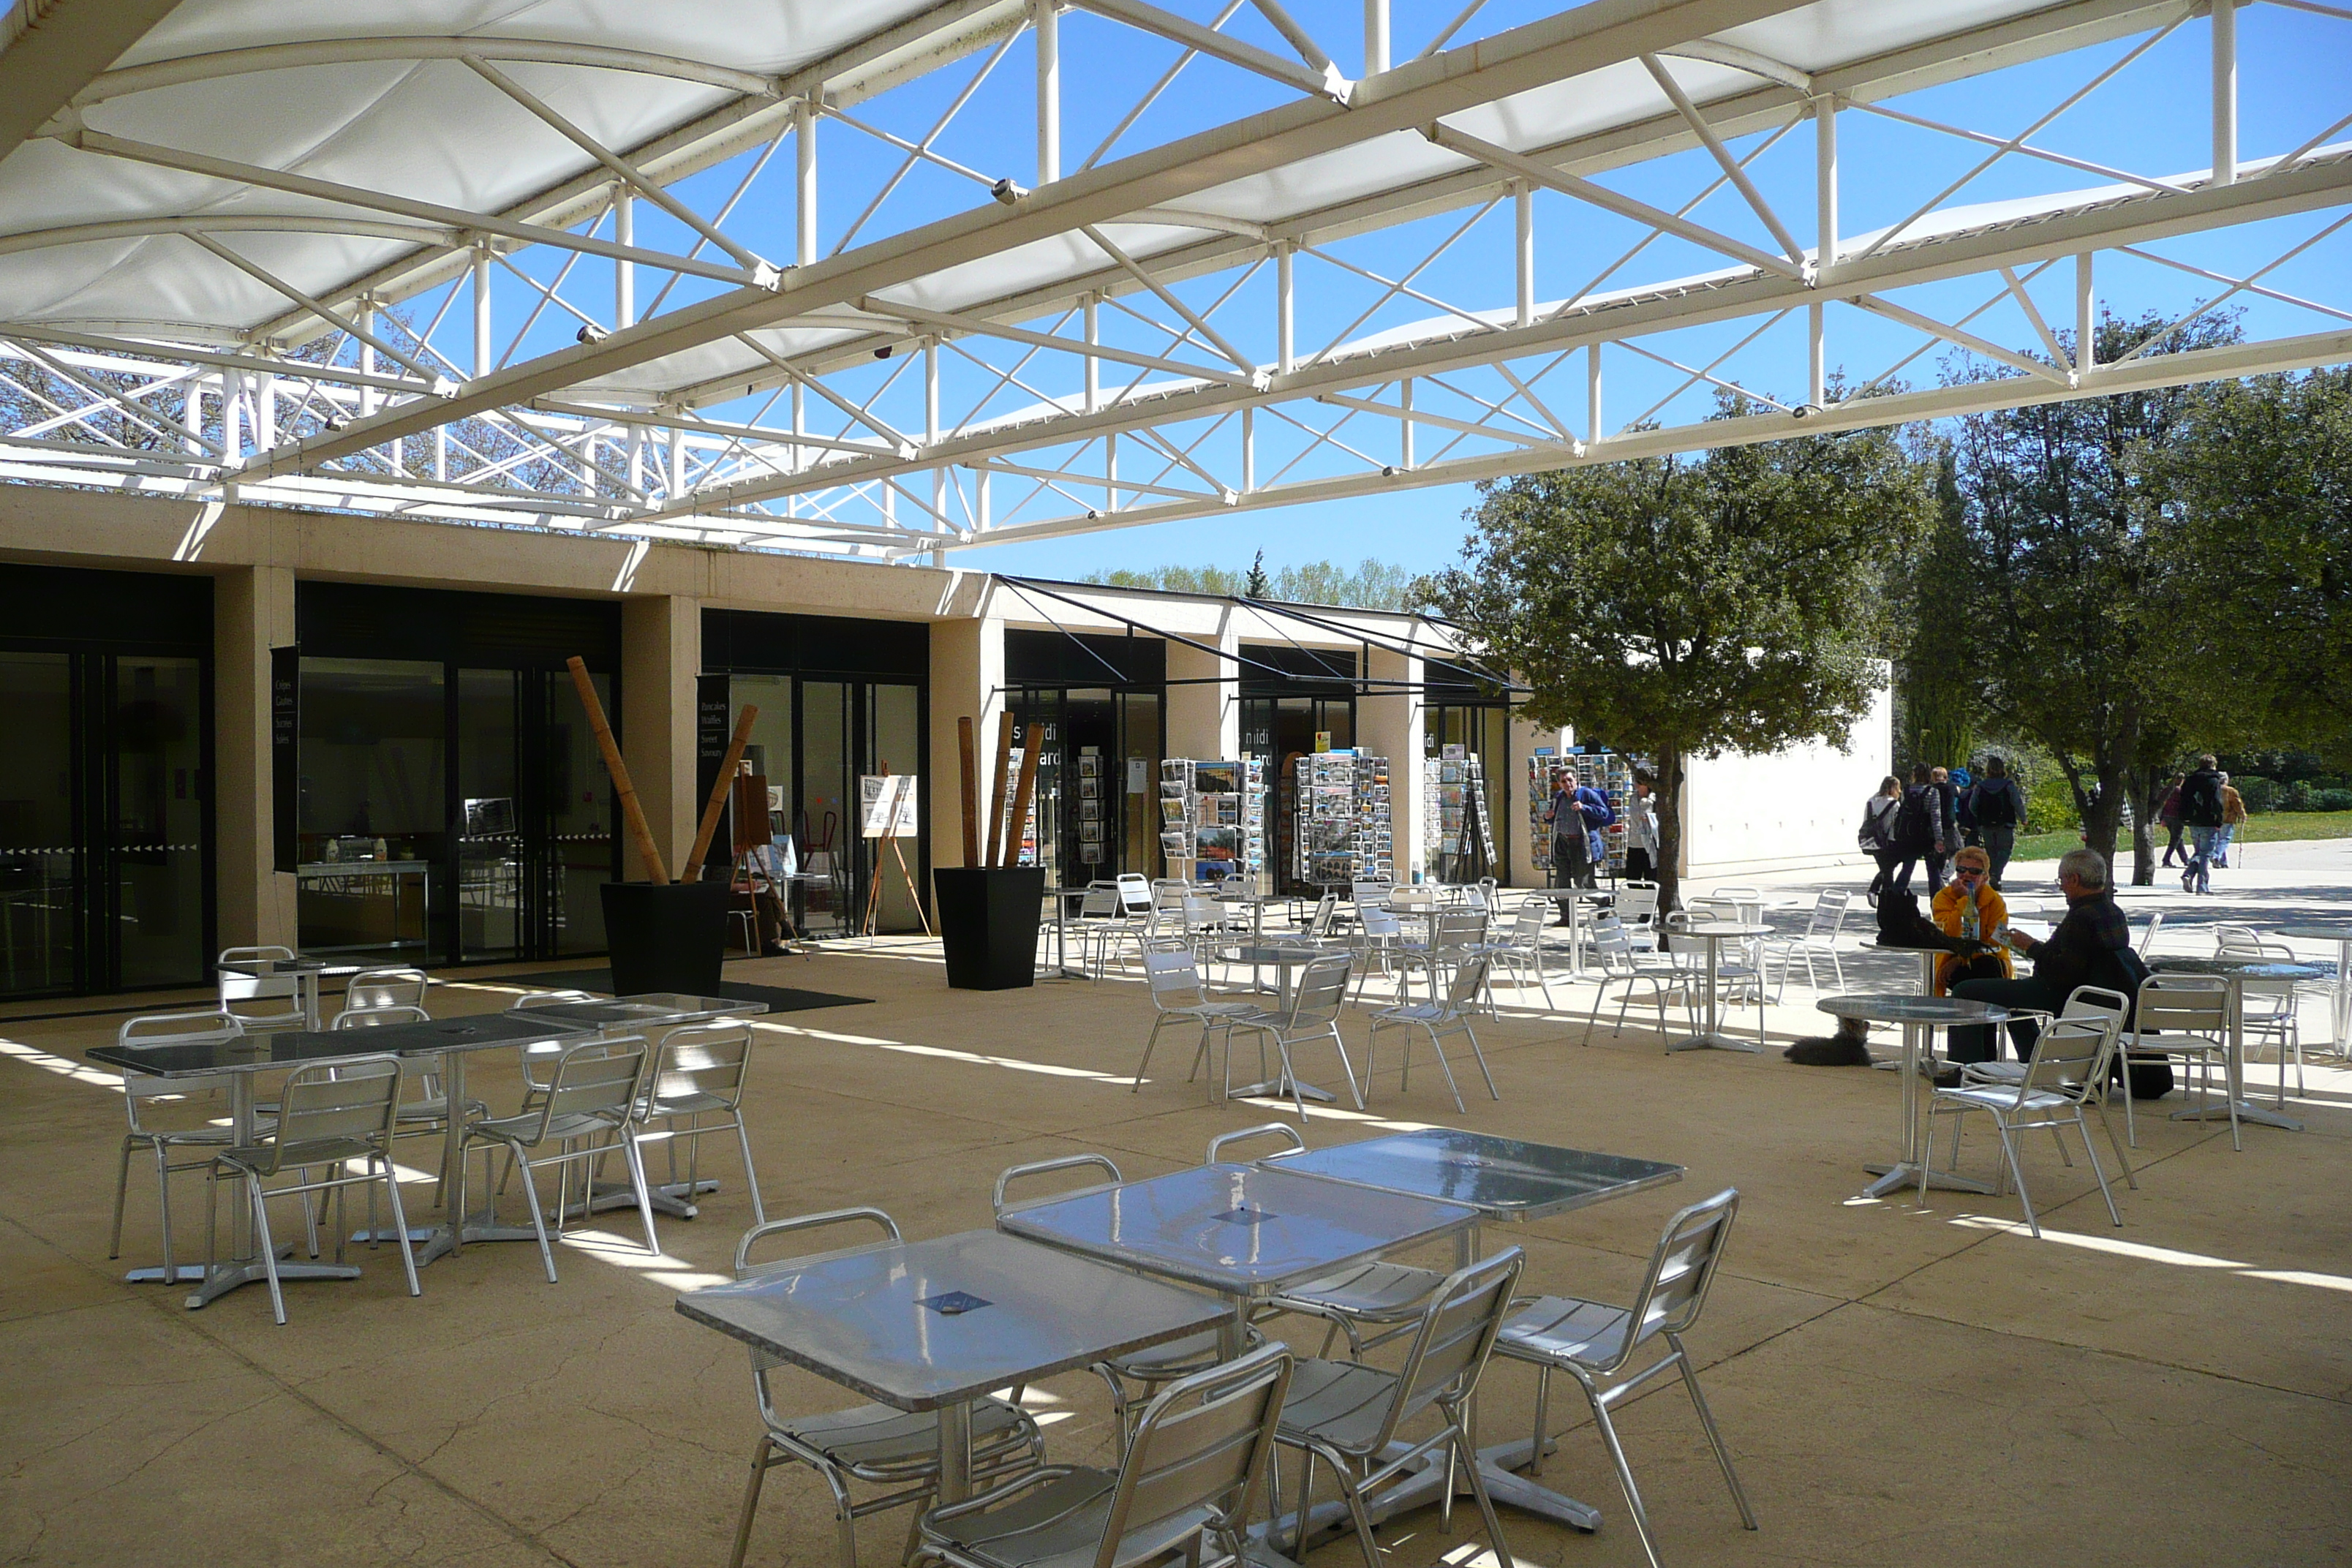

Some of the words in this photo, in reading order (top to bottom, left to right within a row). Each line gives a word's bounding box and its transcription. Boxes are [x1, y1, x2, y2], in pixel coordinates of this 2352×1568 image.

[701, 701, 726, 712] Pancakes
[701, 715, 722, 725] Waffles
[701, 734, 718, 744] Sweet
[701, 747, 723, 759] Savoury
